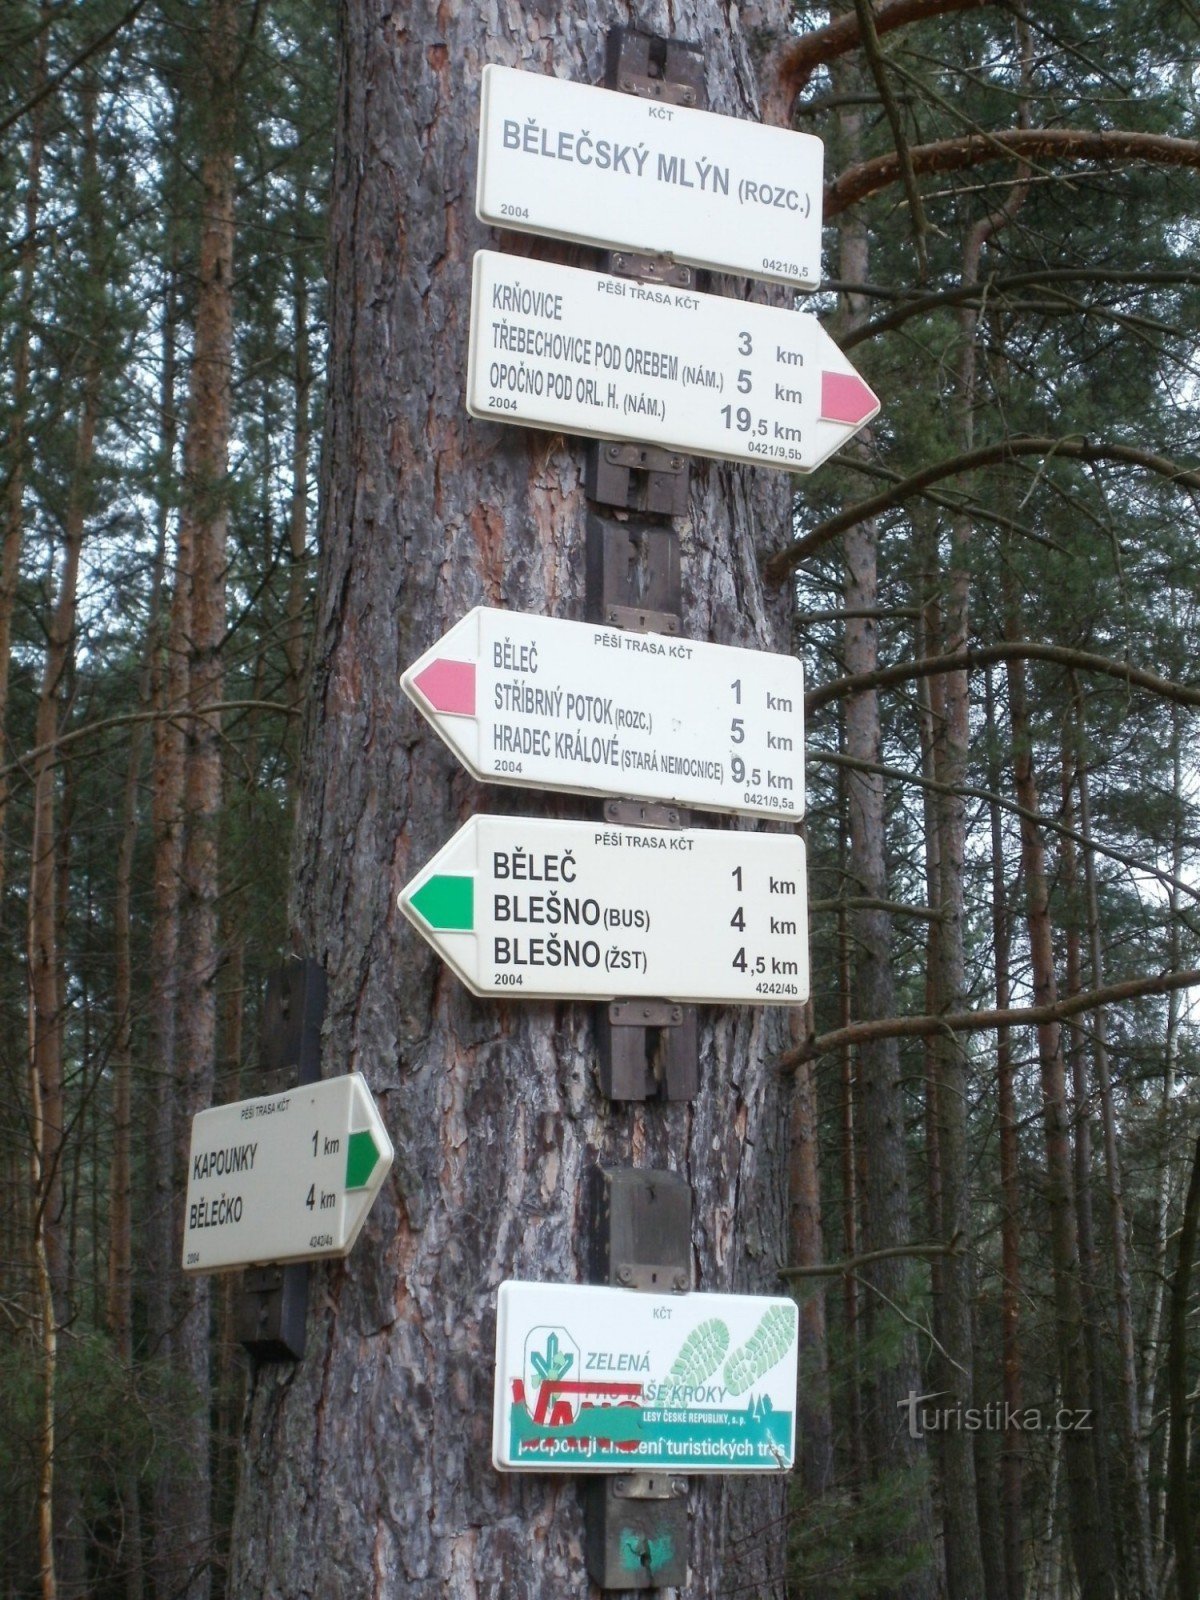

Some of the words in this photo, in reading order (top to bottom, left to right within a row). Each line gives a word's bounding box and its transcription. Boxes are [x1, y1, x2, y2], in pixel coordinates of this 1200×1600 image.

[648, 106, 674, 122] KČT
[503, 117, 650, 177] BĚLEČSKÝ
[657, 153, 730, 196] MLÝN
[738, 179, 811, 219] (ROZC.)
[500, 203, 530, 219] 2004
[762, 258, 809, 278] 0421/9,5
[597, 281, 627, 298] PĚŠÍ
[629, 287, 672, 306] TRASA
[675, 295, 700, 312] KČT
[492, 281, 563, 321] KRŇOVICE
[737, 331, 753, 357] 3
[776, 345, 804, 367] km
[492, 319, 591, 365] TŘEBECHOVICE
[595, 342, 622, 371] POD
[625, 350, 679, 381] OREBEM
[682, 365, 724, 393] (NÁM.)
[737, 369, 753, 394] 5
[774, 382, 802, 405] km
[488, 396, 518, 411] 2004
[490, 361, 544, 397] OPOČNO
[547, 374, 573, 401] POD
[576, 378, 604, 407] ORL.
[607, 383, 620, 410] H.
[623, 392, 666, 422] (NÁM.)
[720, 404, 768, 438] 19,5
[774, 421, 802, 443] km
[747, 441, 802, 461] 0421/9,5b
[594, 633, 623, 650] PĚŠÍ
[624, 638, 666, 656] TRASA
[668, 644, 694, 661] KČT
[493, 637, 539, 674] BĚLEČ
[730, 679, 742, 704] 1
[766, 692, 793, 713] km
[494, 679, 563, 718] STŘÍBRNÝ
[566, 695, 613, 724] POTOK
[615, 707, 653, 736] (ROZC.)
[730, 719, 745, 744] 5
[766, 731, 793, 752] km
[493, 724, 551, 757] HRADEC
[554, 730, 619, 767] KRÁLOVÉ
[621, 748, 658, 773] (STARÁ
[660, 756, 724, 785] NEMOCNICE)
[730, 757, 761, 786] 9,5
[766, 770, 793, 791] km
[494, 759, 523, 774] 2004
[744, 793, 795, 810] 0421/9,5a
[594, 832, 623, 847] PĚŠÍ
[625, 835, 666, 850] TRASA
[669, 837, 695, 851] KČT
[493, 847, 577, 883] BĚLEČ
[731, 866, 743, 891] 1
[768, 876, 796, 895] km
[494, 890, 601, 926] BLEŠNO
[603, 909, 651, 933] (BUS)
[730, 906, 746, 932] 4
[769, 916, 797, 935] km
[494, 933, 601, 968] BLEŠNO
[604, 946, 648, 975] (ŽST)
[732, 947, 765, 976] 4,5
[771, 956, 798, 976] km
[494, 974, 523, 986] 2004
[755, 982, 798, 995] 4242/4b
[256, 1102, 275, 1117] TRASA
[193, 1143, 258, 1180] KAPOUNKY
[312, 1130, 319, 1157] 1
[324, 1138, 340, 1155] km
[189, 1193, 243, 1229] BĚLEČKO
[306, 1183, 316, 1211] 4
[320, 1192, 336, 1210] km
[653, 1306, 673, 1320] KČT
[585, 1350, 651, 1373] ZELENÁ
[671, 1383, 728, 1404] KROKY
[643, 1410, 661, 1423] LESY
[663, 1408, 687, 1423] ČESKÉ
[666, 1437, 754, 1461] turistických
